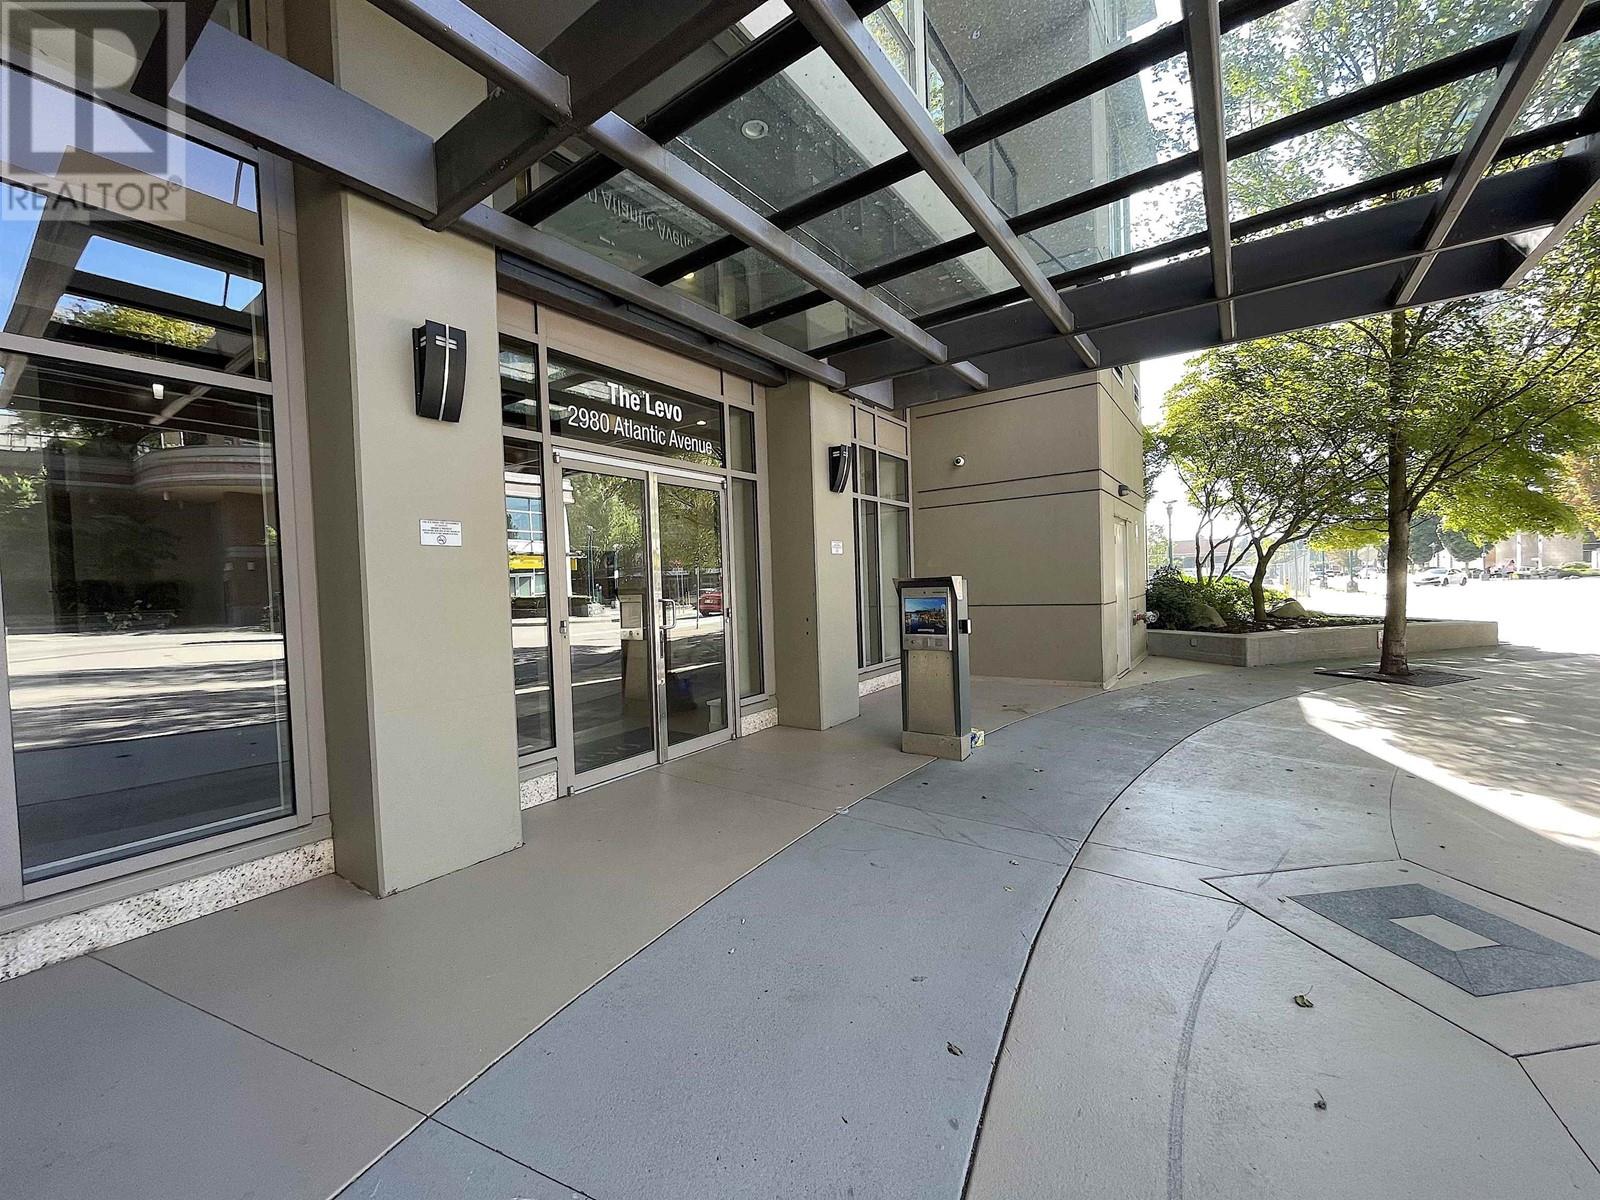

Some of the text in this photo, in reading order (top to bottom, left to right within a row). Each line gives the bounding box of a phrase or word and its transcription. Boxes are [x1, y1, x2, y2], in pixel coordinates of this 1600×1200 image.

[607, 381, 682, 422] The Levo
[567, 405, 713, 454] 2980 Atlantic Avenue
